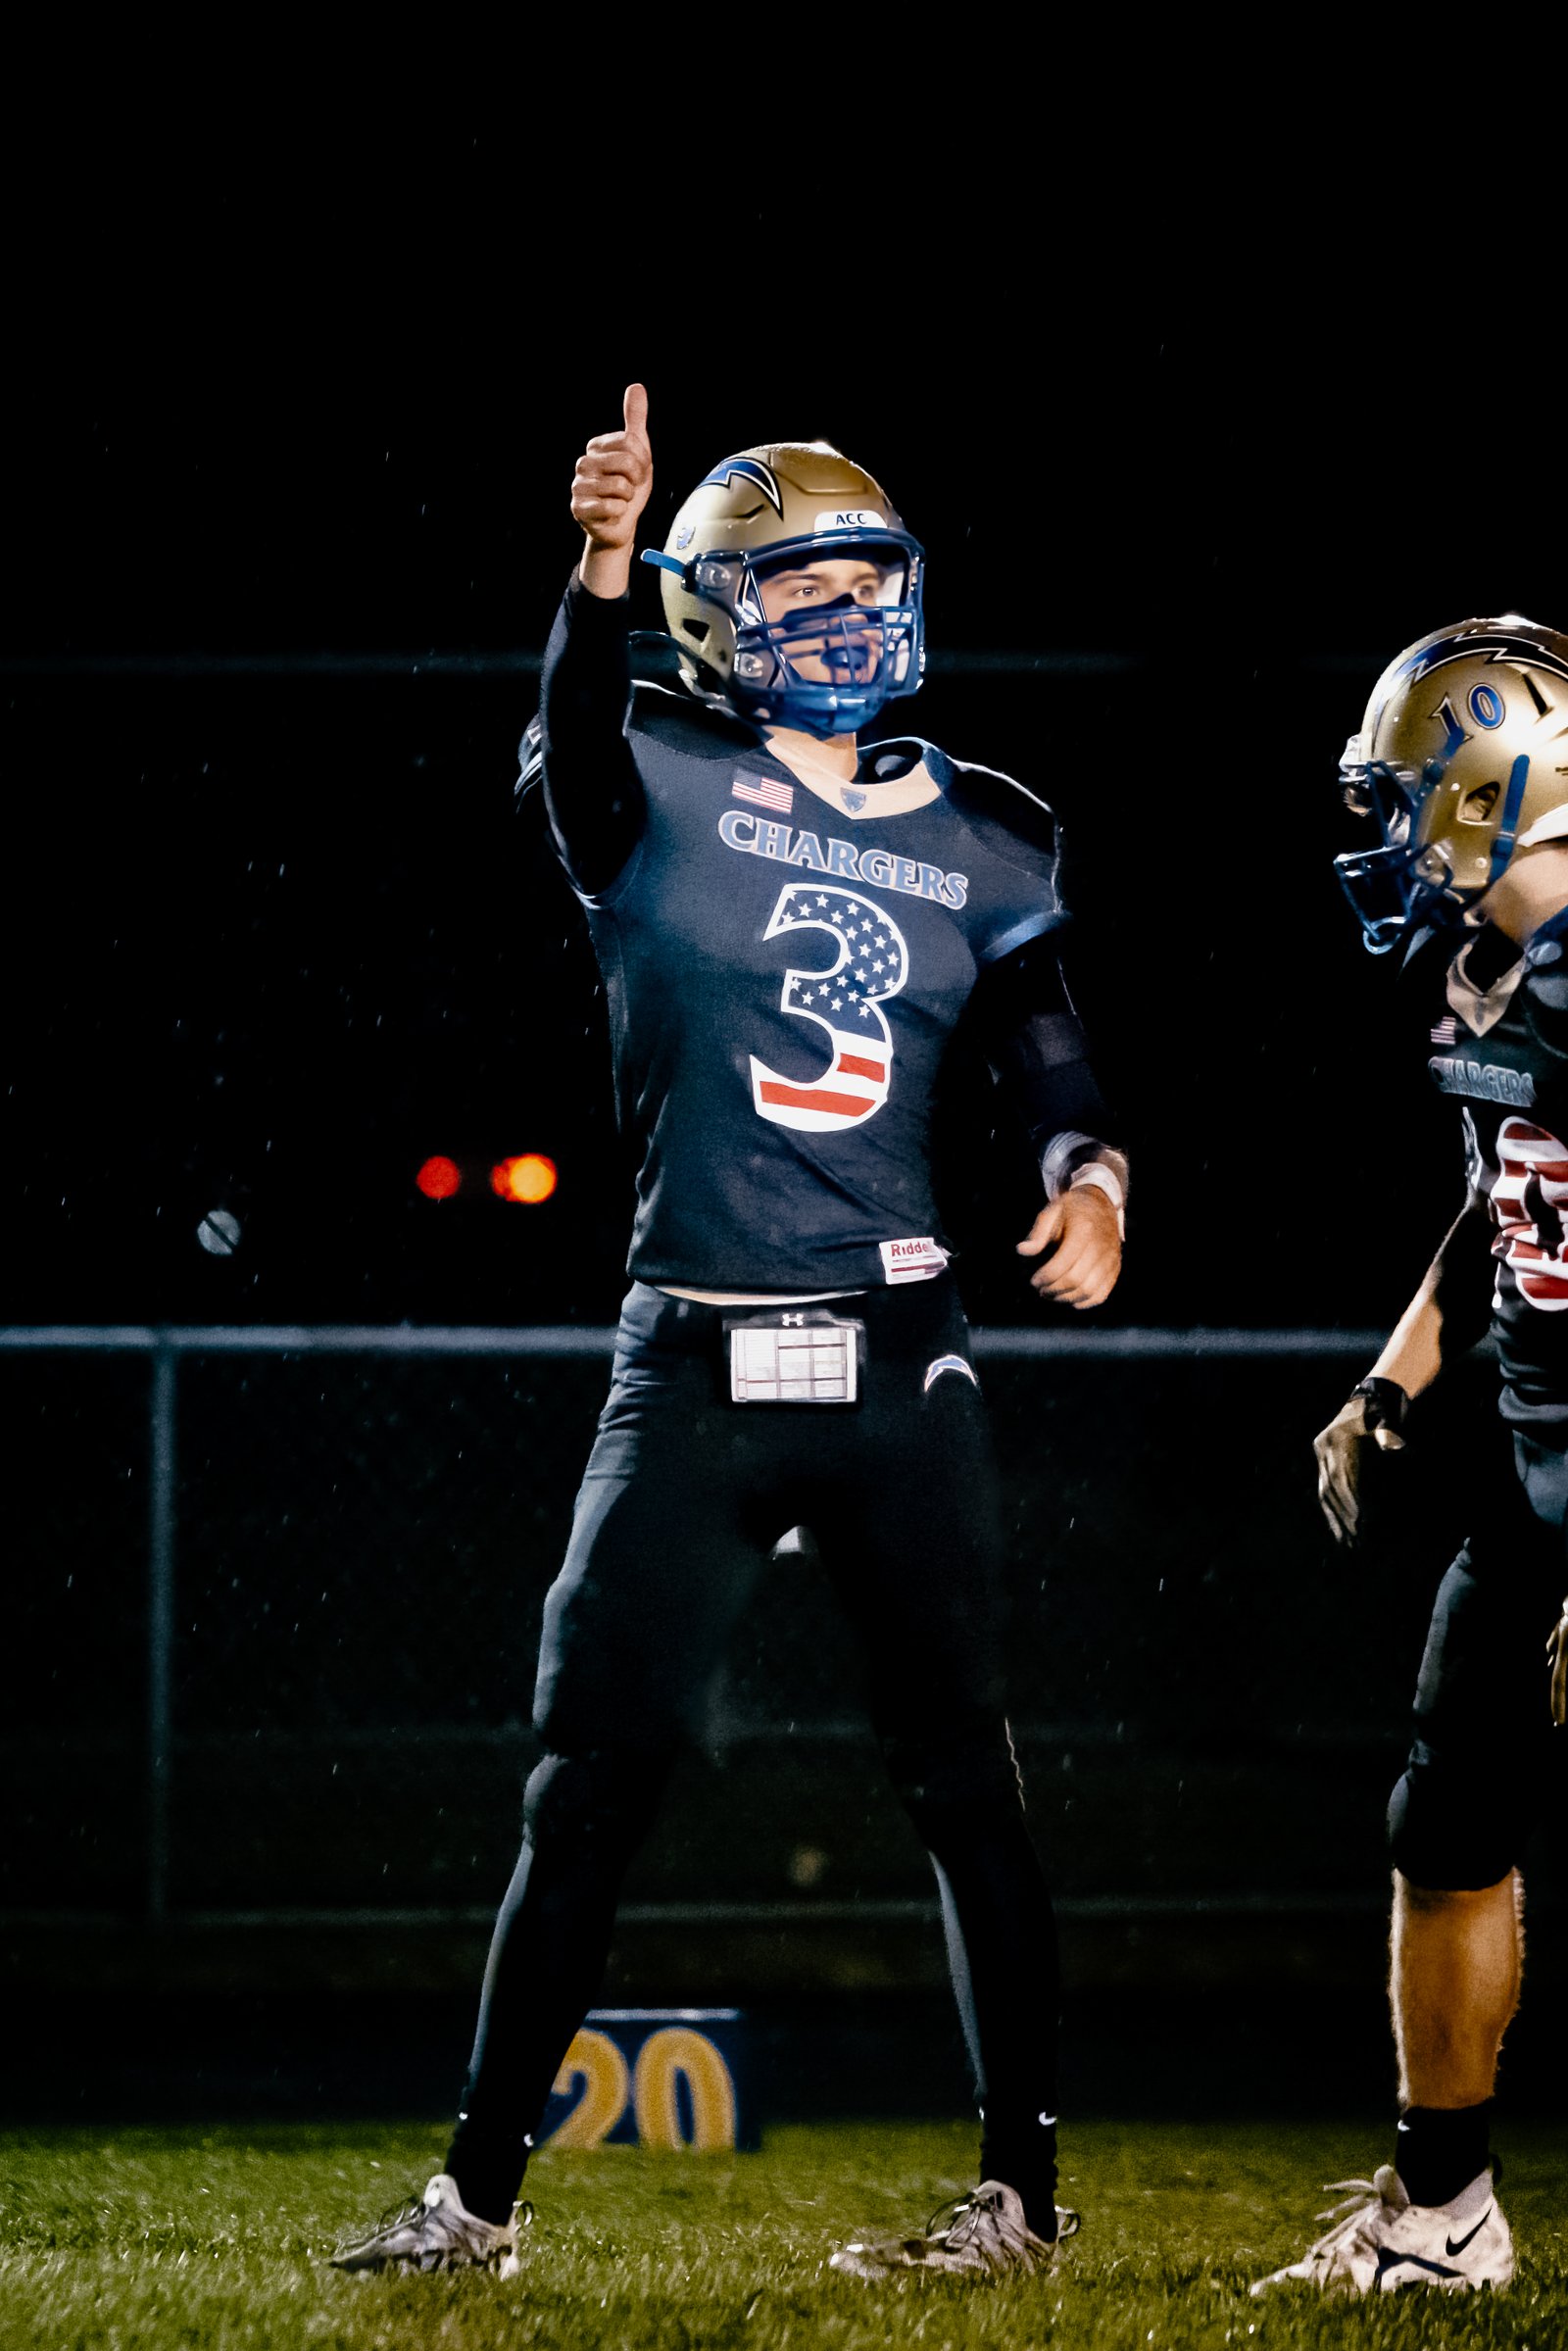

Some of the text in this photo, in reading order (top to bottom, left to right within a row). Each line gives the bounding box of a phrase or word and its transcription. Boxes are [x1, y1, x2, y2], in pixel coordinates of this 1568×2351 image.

[836, 513, 867, 525] ACC
[1428, 682, 1506, 747] 10
[717, 810, 969, 911] CHARGERS
[749, 883, 909, 1133] 3
[890, 1241, 933, 1257] Ridde
[542, 2025, 738, 2150] 20
